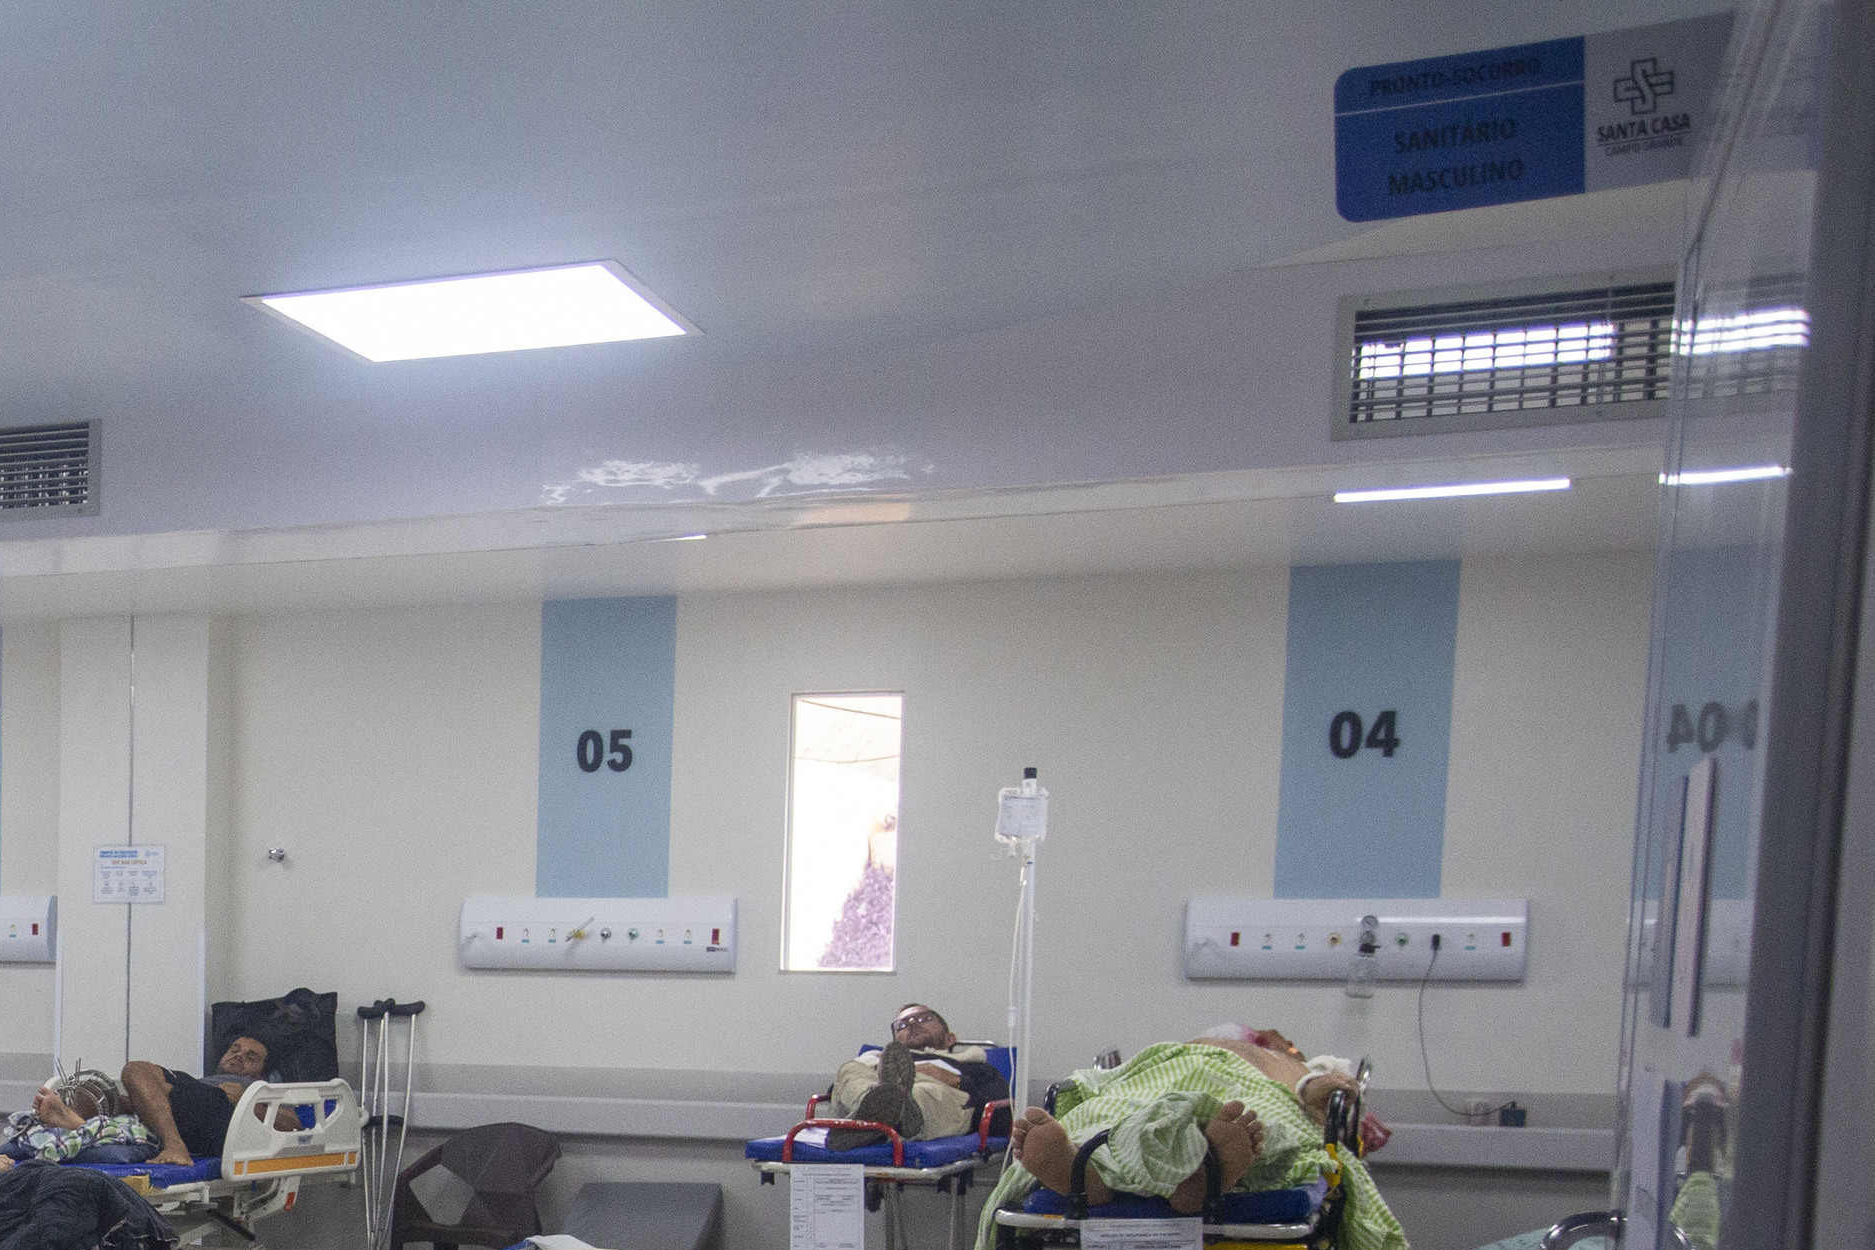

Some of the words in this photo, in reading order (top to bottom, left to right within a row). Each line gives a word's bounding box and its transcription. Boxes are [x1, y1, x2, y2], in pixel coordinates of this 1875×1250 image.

[1369, 56, 1542, 99] PRONTO-SOCORRO
[1394, 112, 1517, 155] SANITÁRIO
[1597, 119, 1649, 144] SANTA
[1651, 112, 1691, 135] CASA
[1388, 158, 1524, 196] MASCULINO
[576, 729, 633, 773] 05
[1328, 709, 1401, 760] 04
